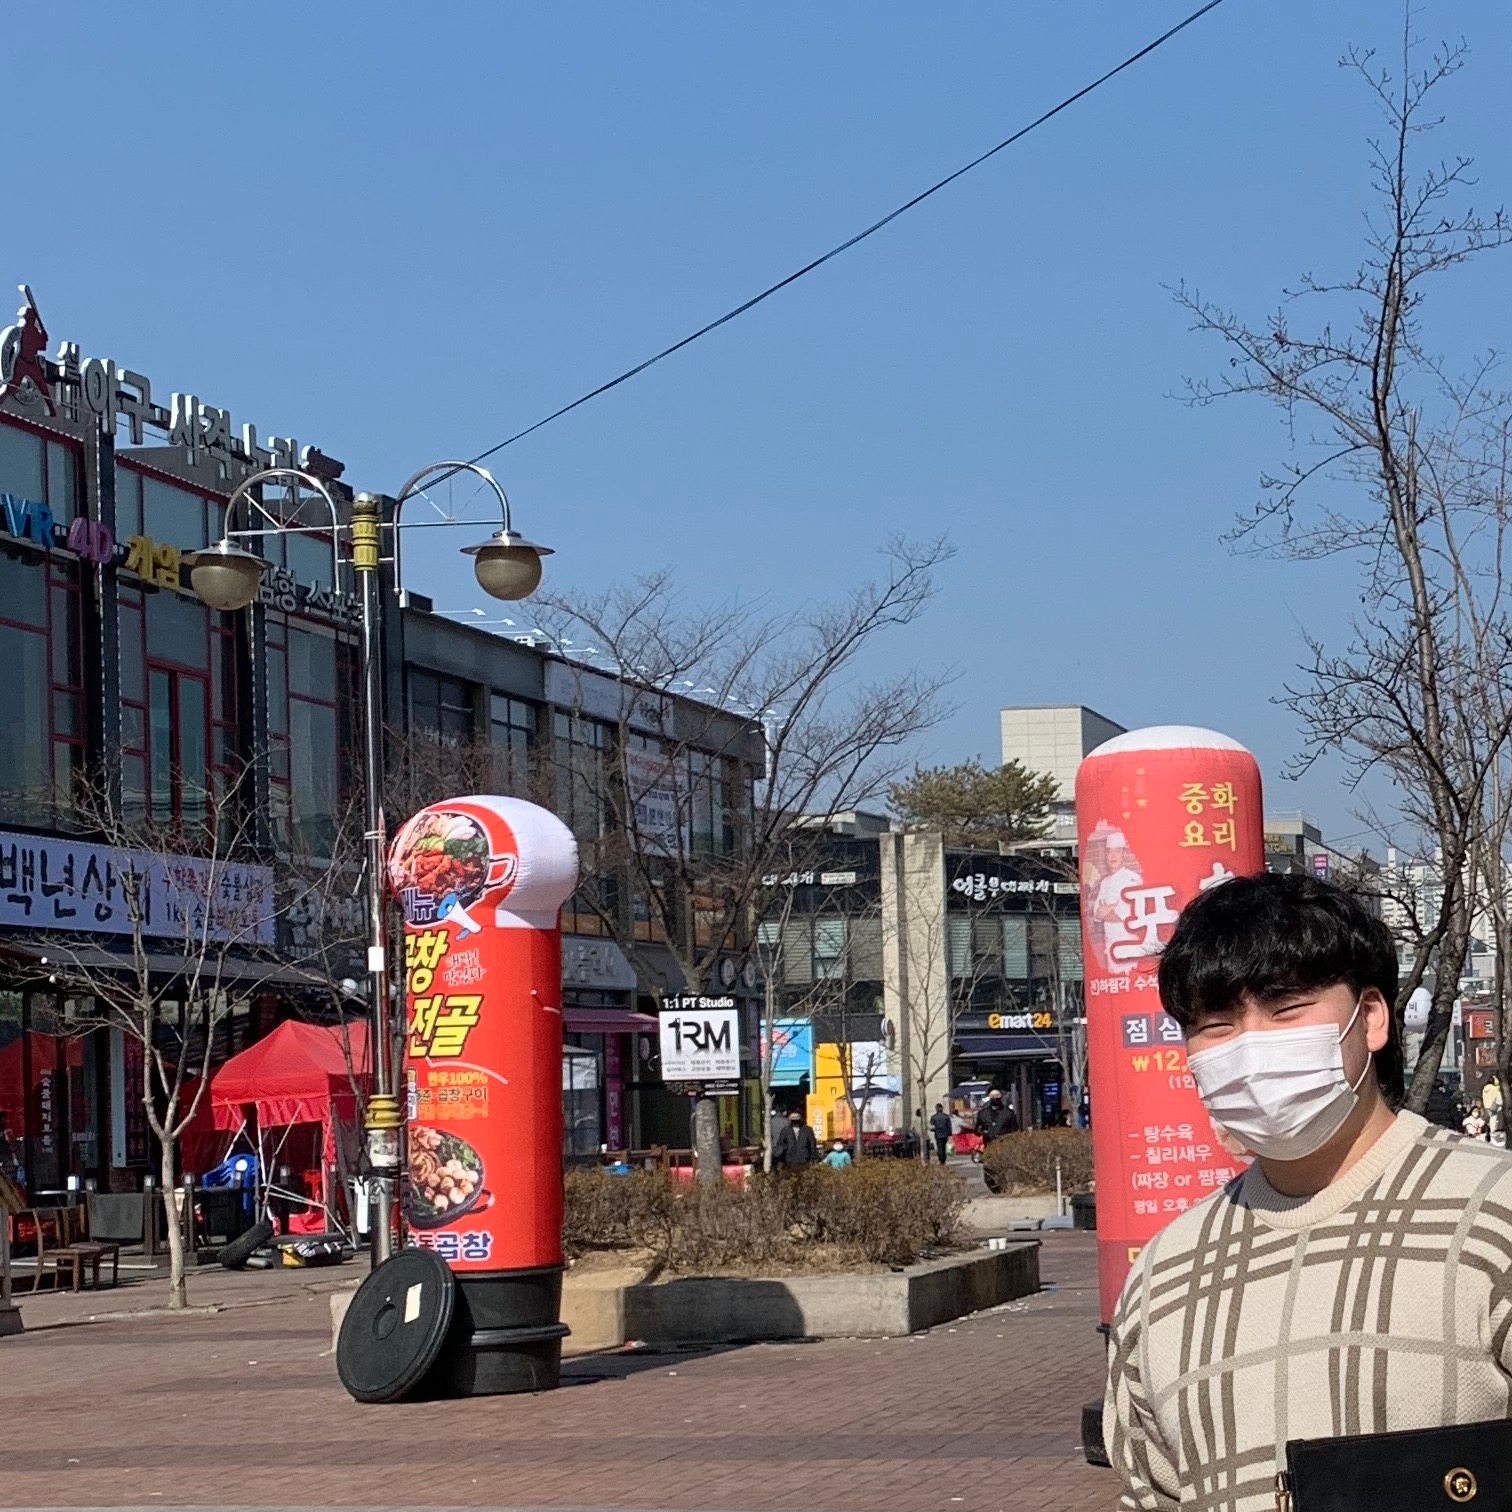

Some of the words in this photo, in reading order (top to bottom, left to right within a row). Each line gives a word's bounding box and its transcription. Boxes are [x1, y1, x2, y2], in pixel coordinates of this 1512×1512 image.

[2, 492, 55, 547] VR
[67, 516, 113, 564] 4D
[1177, 782, 1238, 815] 중화
[1178, 818, 1236, 851] 요리
[663, 998, 680, 1009] 1:1
[682, 997, 697, 1008] PT
[699, 996, 734, 1008] Studio
[409, 994, 484, 1058] 전골
[988, 1013, 1052, 1029] emart24
[1126, 1018, 1182, 1043] 점심
[668, 1018, 731, 1054] 1RM
[1144, 1124, 1194, 1142] 탕수육
[1146, 1144, 1212, 1164] 칠리새우
[1132, 1172, 1169, 1190] (짜장
[1174, 1174, 1191, 1187] or
